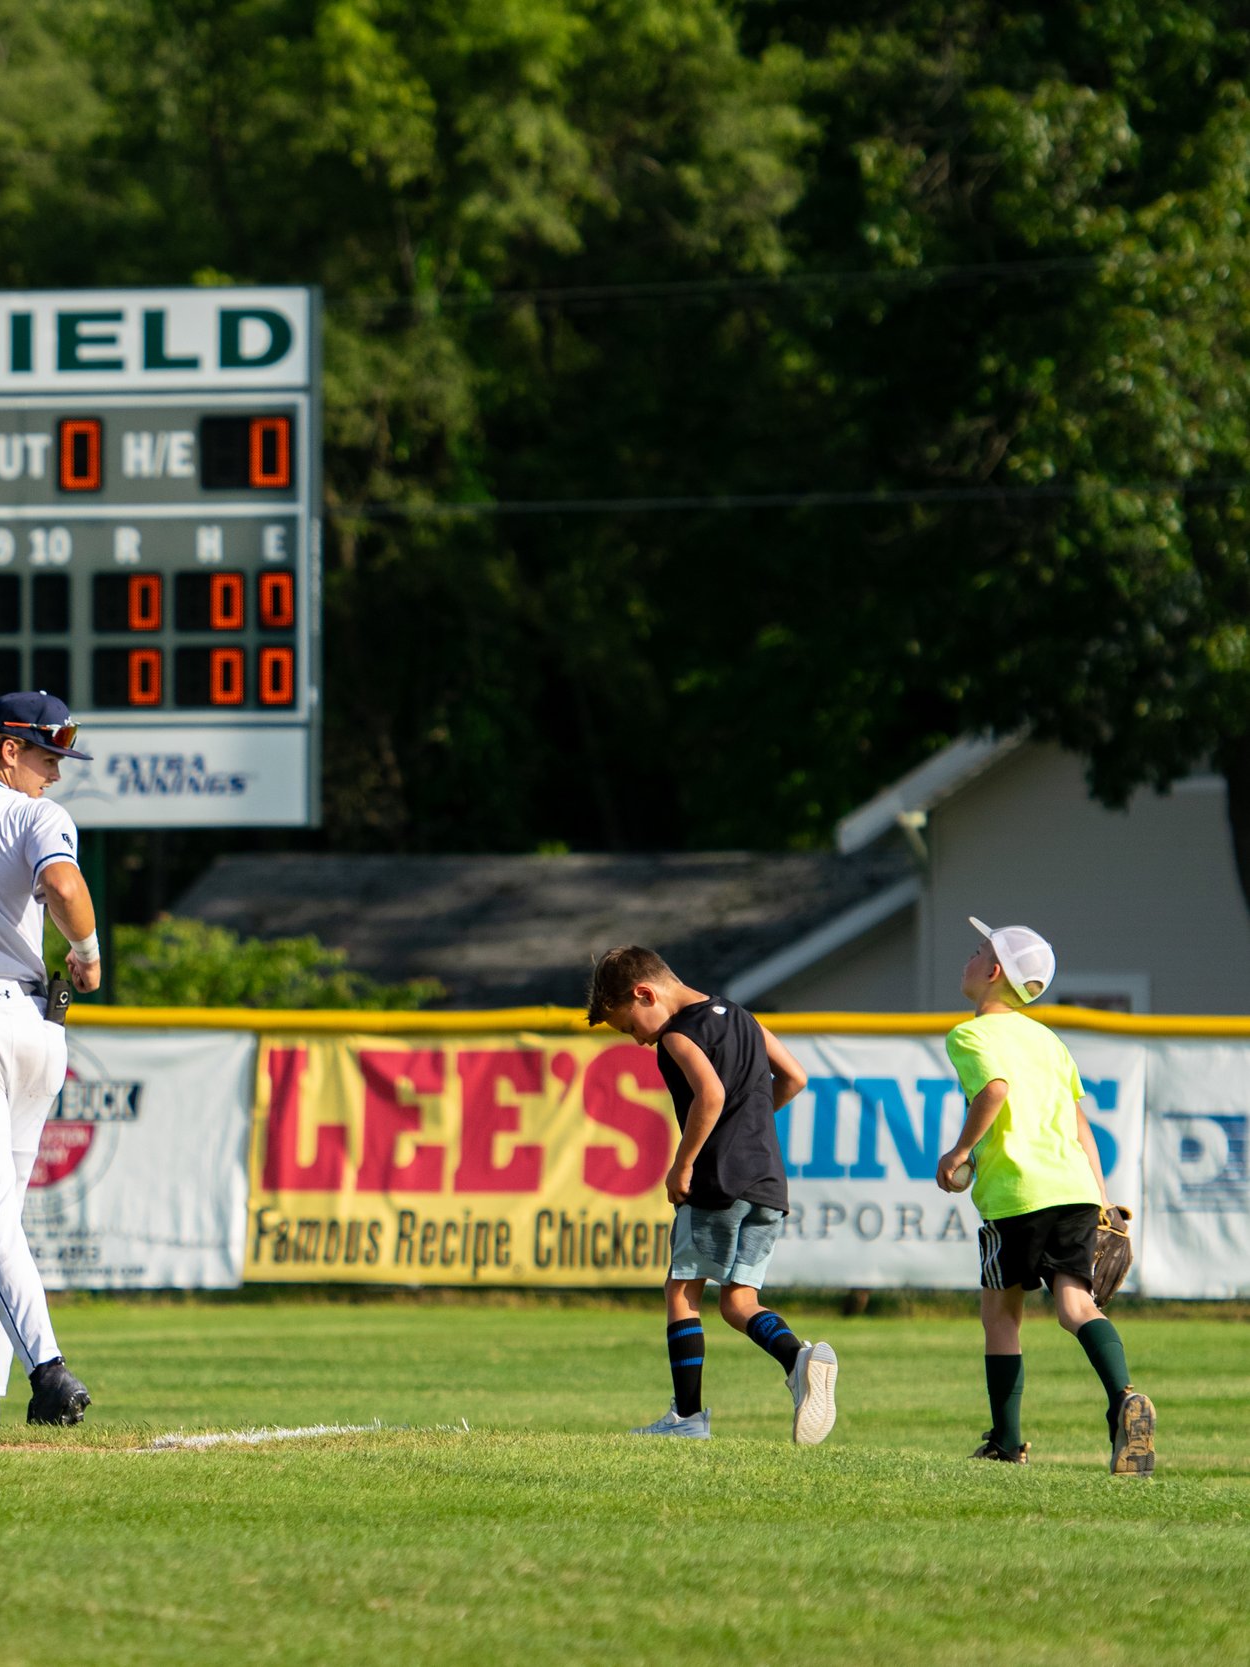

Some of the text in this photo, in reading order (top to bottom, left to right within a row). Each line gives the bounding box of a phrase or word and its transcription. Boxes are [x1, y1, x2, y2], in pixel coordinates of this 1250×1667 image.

[60, 419, 101, 490] 0
[123, 432, 196, 478] H/E
[250, 417, 290, 488] 0
[30, 526, 71, 565] 10
[113, 527, 142, 564] R
[196, 526, 223, 563] H
[263, 525, 287, 562] E
[128, 574, 162, 631] 0
[210, 573, 244, 630] 0
[259, 572, 293, 627] 0
[128, 647, 293, 705] 0 0 0
[106, 753, 207, 775] EXTRA
[261, 1044, 671, 1197] LEE'S
[253, 1208, 670, 1276] Famous Recipe Chicken
